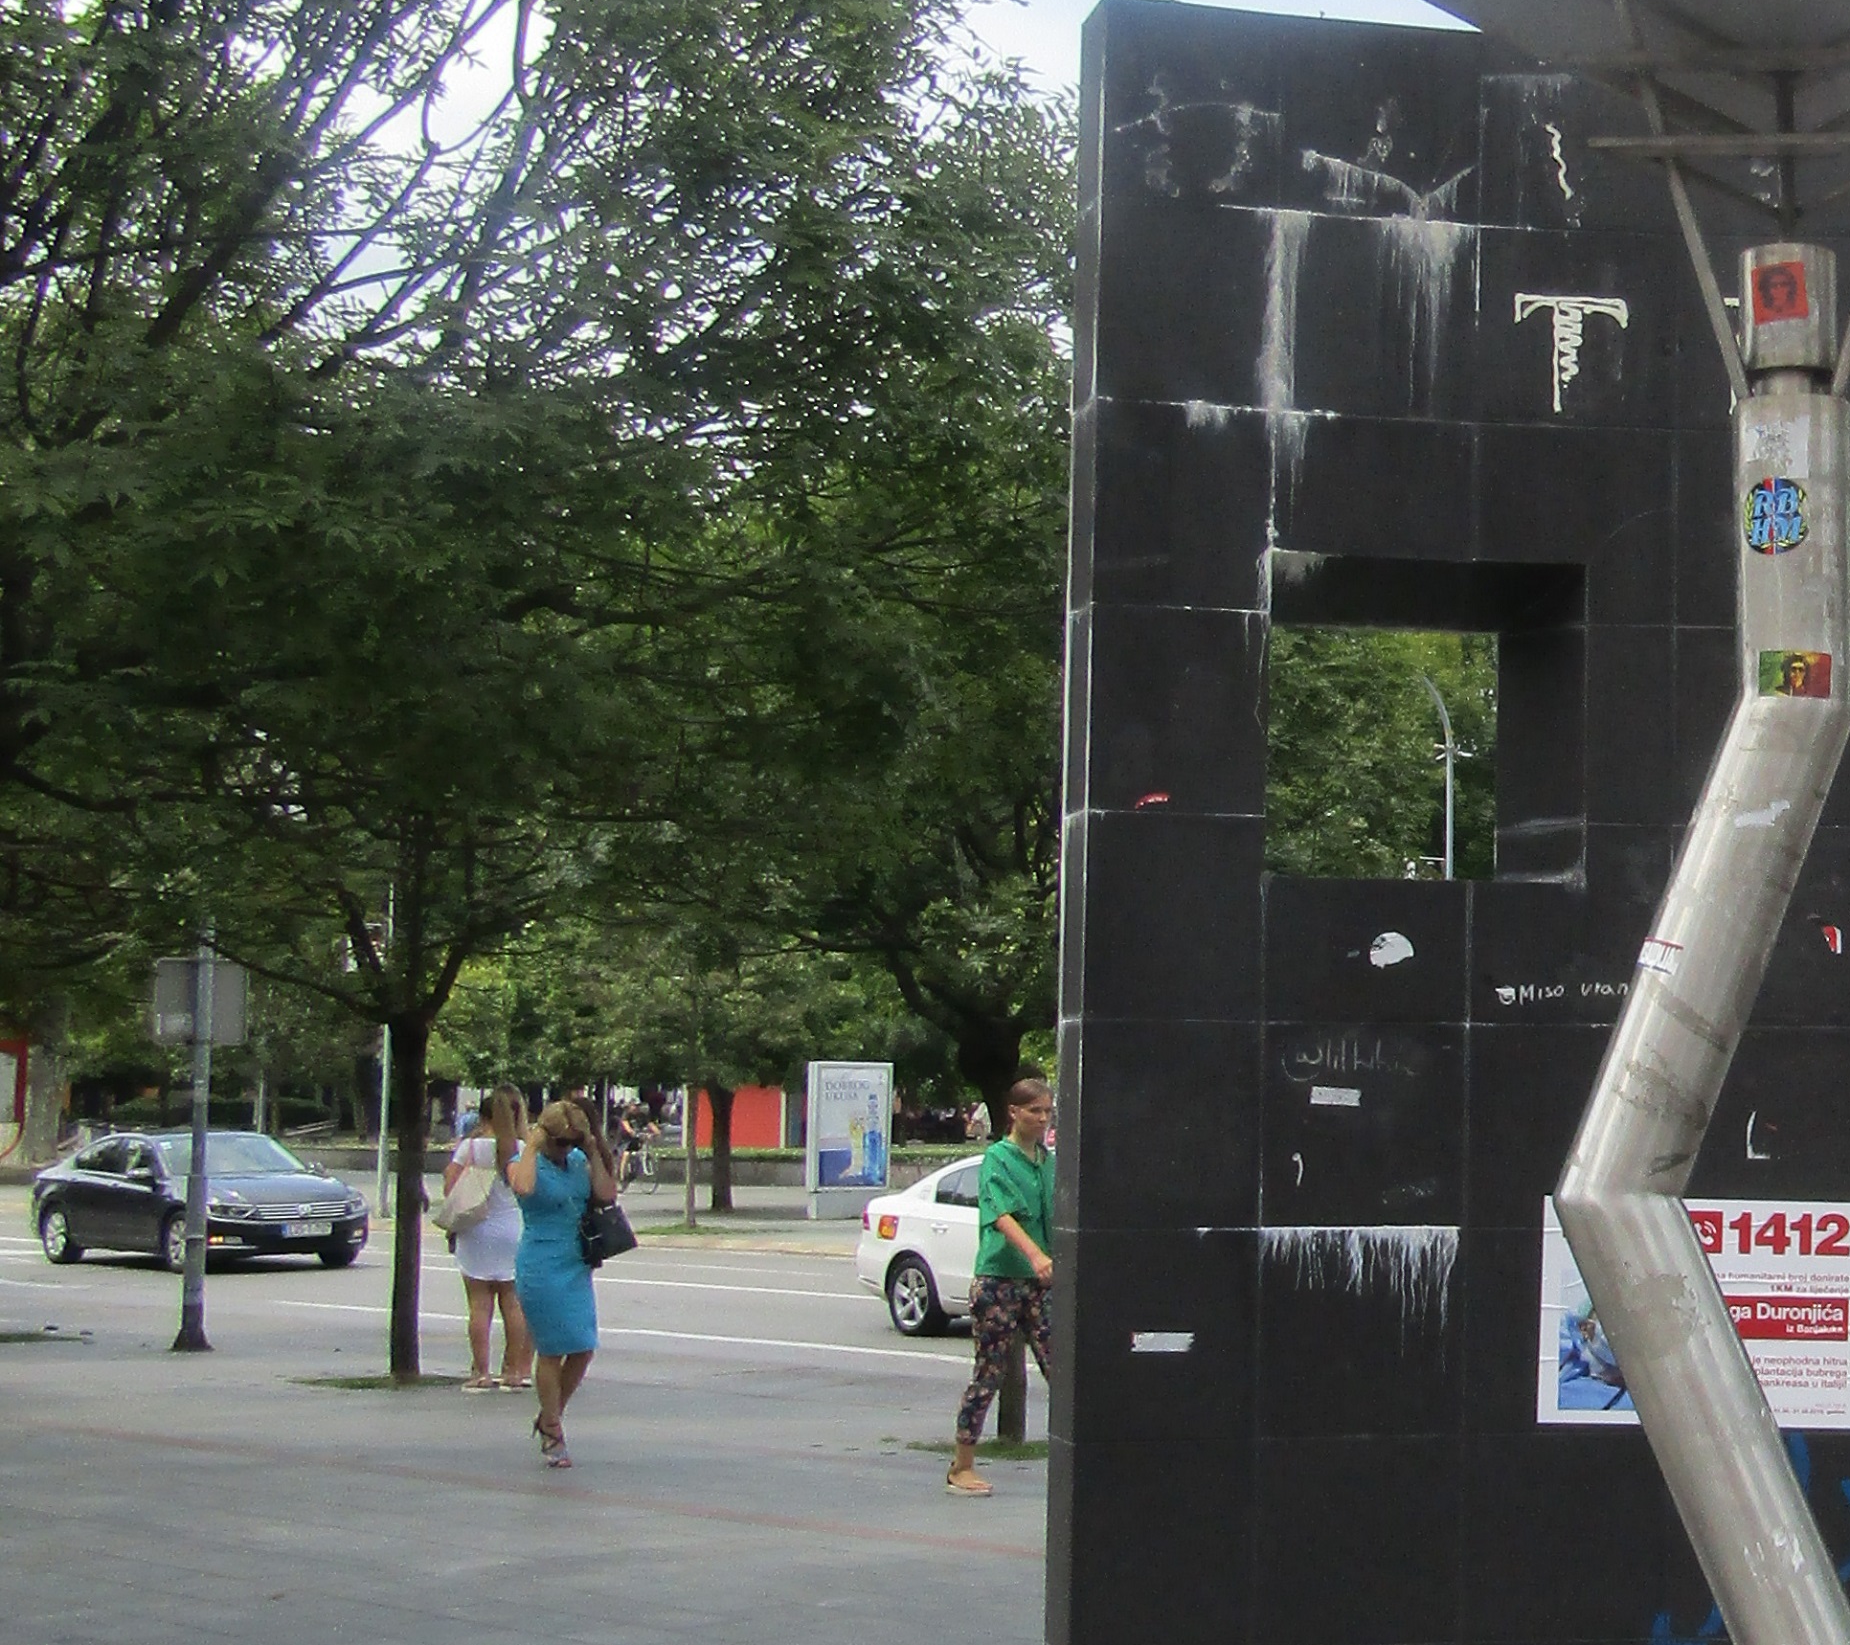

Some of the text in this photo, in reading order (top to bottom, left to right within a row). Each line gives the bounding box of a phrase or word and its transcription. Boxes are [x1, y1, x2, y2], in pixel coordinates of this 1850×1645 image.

[1729, 1212, 1850, 1256] 1412
[1728, 1271, 1786, 1281] humanitarni
[1788, 1272, 1808, 1284] broj
[1810, 1273, 1850, 1283] donirate
[1729, 1301, 1844, 1325] ga Duronjića
[1785, 1324, 1795, 1334] iz
[1763, 1356, 1821, 1367] neophodna
[1822, 1357, 1848, 1367] hitna
[1756, 1367, 1848, 1379] plantacija bubrega
[1811, 1380, 1819, 1388] u
